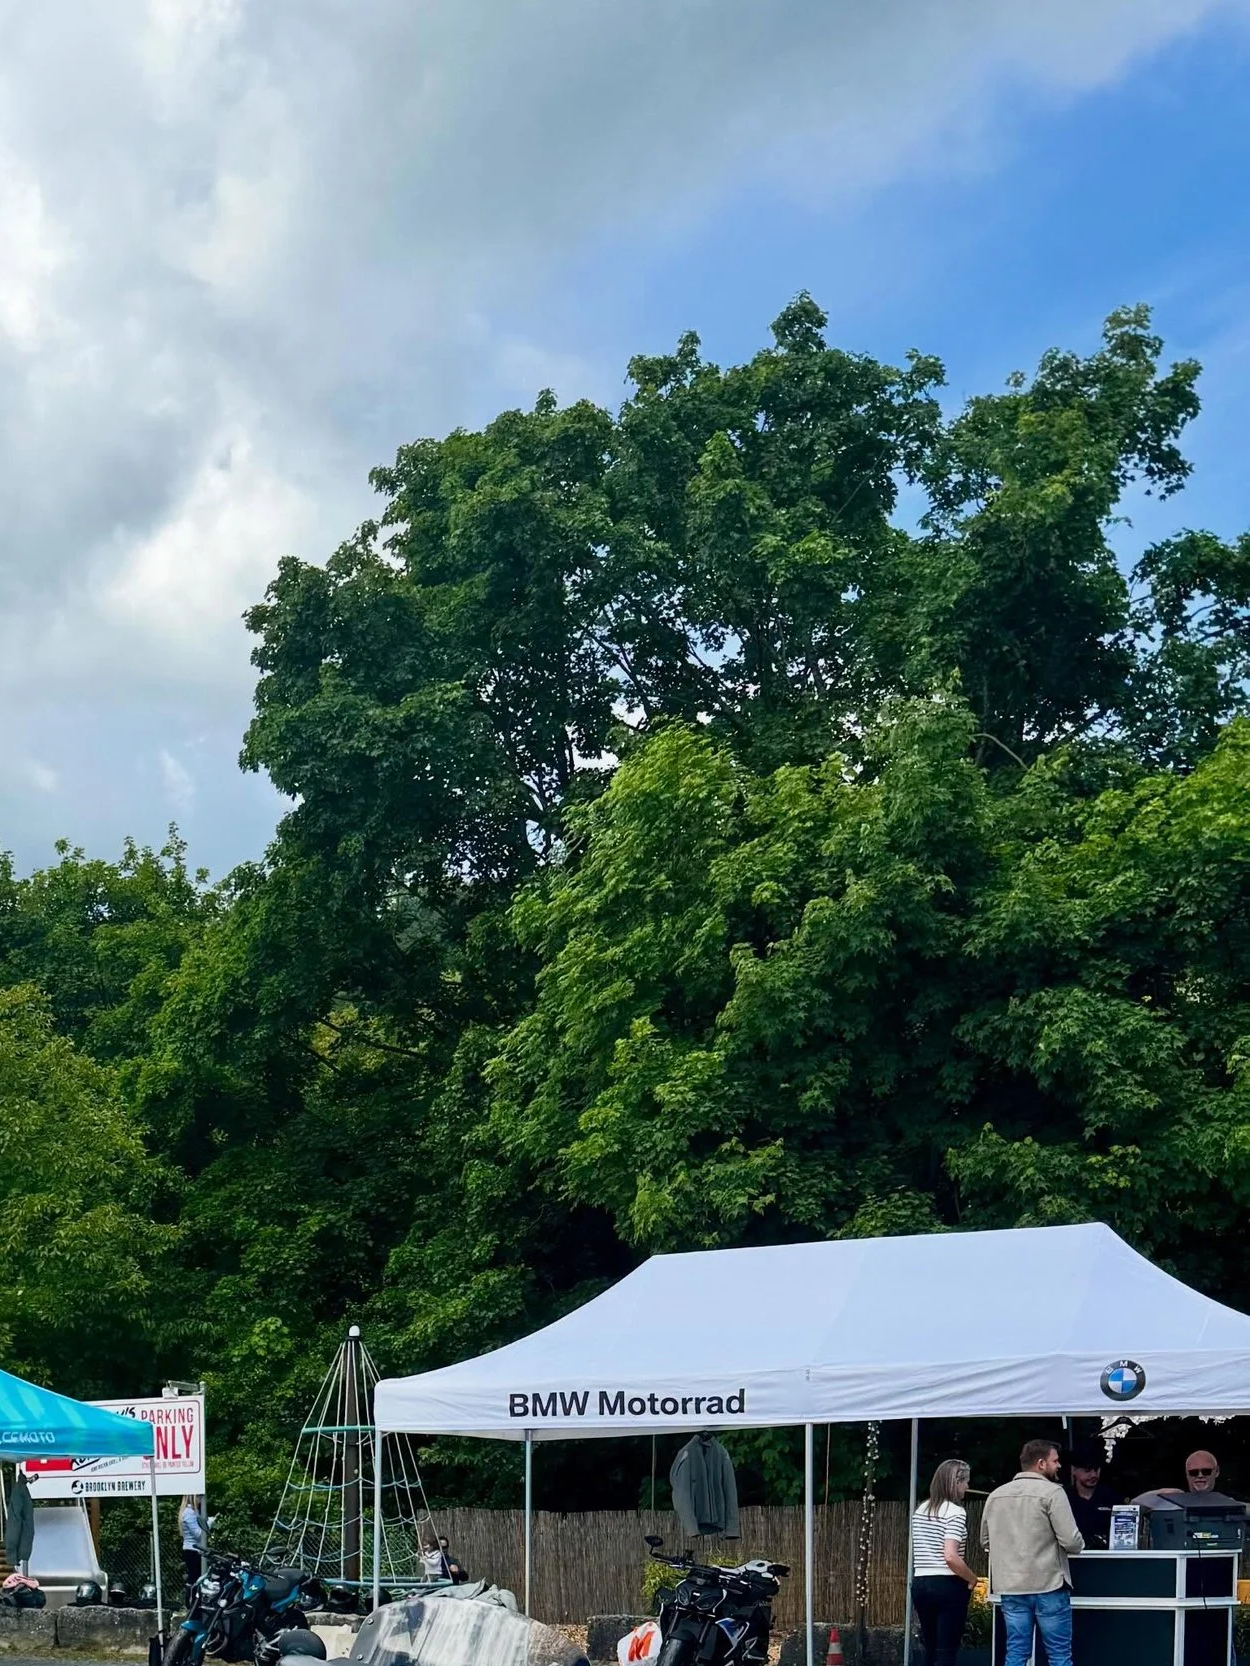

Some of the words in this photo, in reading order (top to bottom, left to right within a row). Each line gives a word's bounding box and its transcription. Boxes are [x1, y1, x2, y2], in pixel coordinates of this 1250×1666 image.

[1105, 1360, 1143, 1375] BMW
[509, 1390, 590, 1418] BMW
[598, 1388, 745, 1416] Motorrad
[141, 1407, 194, 1424] PARKING
[1, 1431, 56, 1445] CFMOTO
[143, 1425, 194, 1460] NLY
[85, 1481, 116, 1493] BROOKLYN
[118, 1480, 146, 1492] BREWERY
